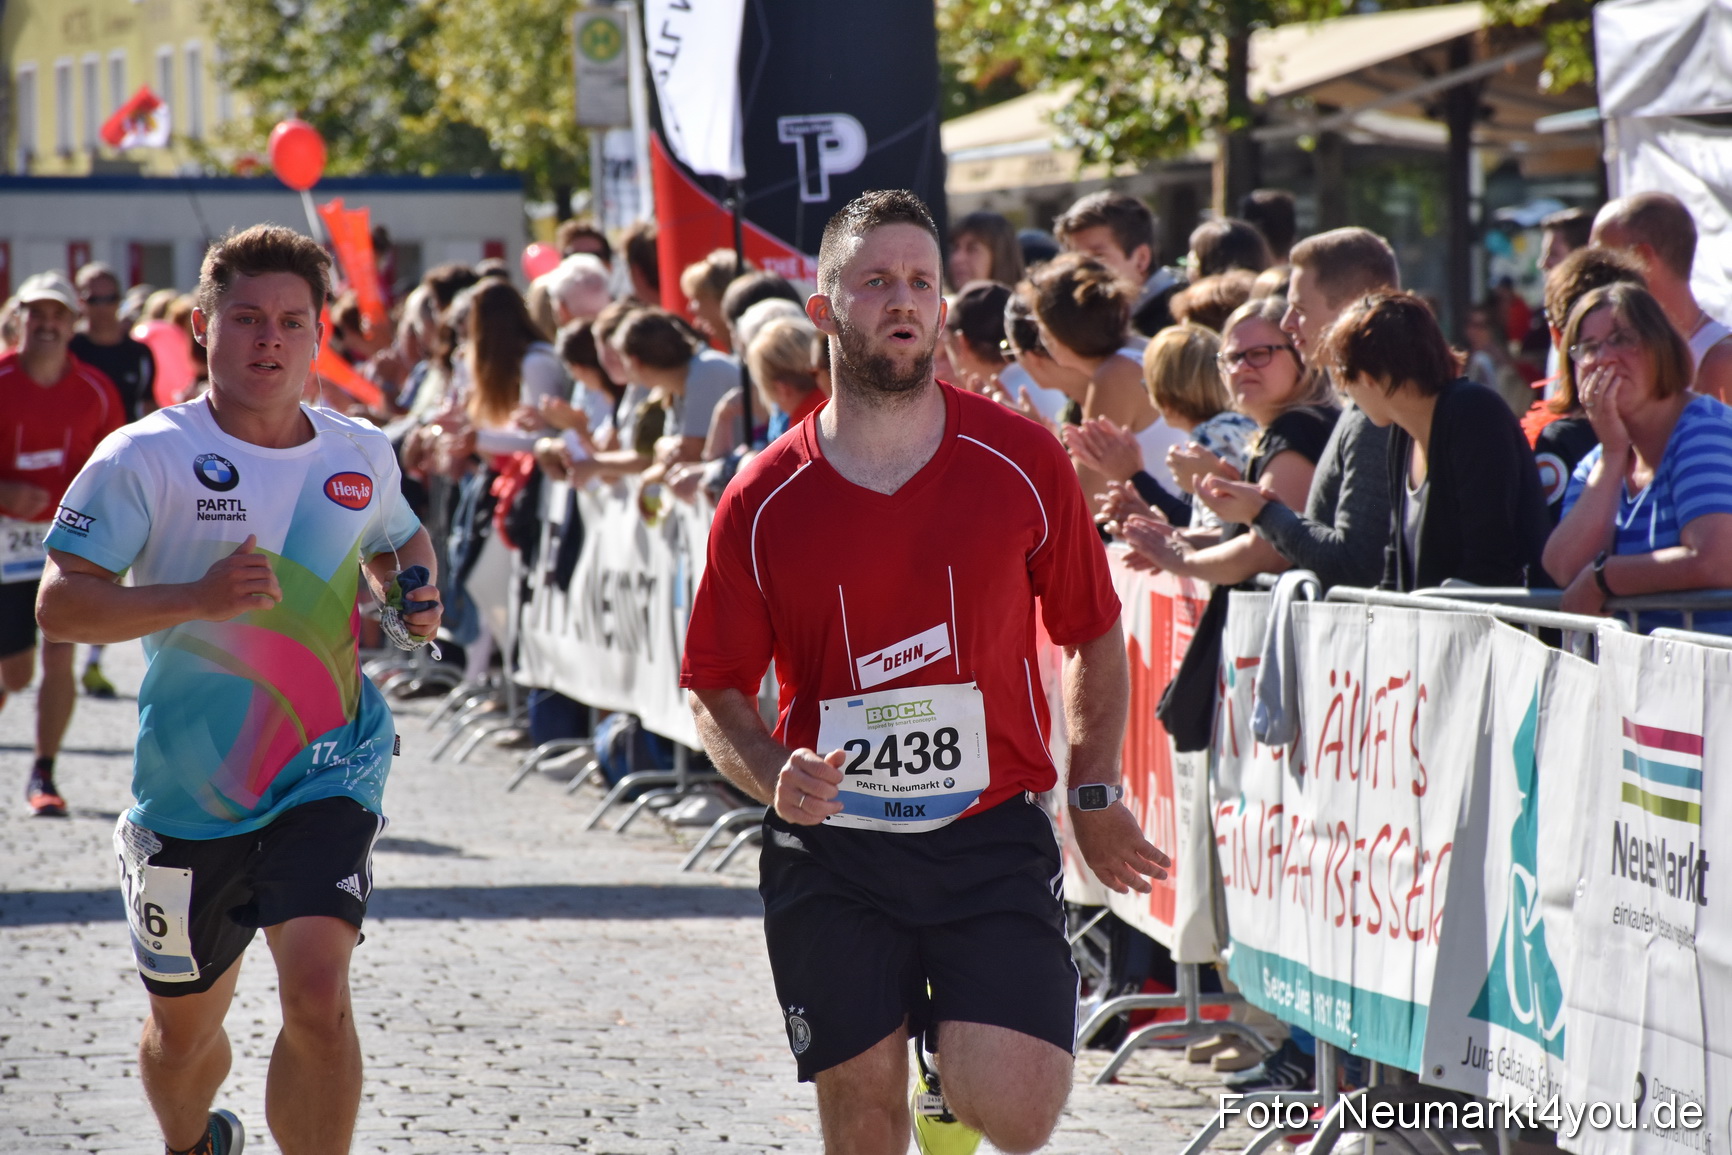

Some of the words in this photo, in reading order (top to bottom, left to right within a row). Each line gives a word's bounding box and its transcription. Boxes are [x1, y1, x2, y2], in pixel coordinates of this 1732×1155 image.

[196, 452, 233, 468] BMW
[332, 481, 370, 500] Hervis
[196, 499, 247, 513] PARTL
[196, 512, 247, 522] Neumarkt
[883, 642, 924, 673] DEHN
[866, 699, 936, 725] BOCK
[867, 722, 887, 731] inspired
[895, 719, 912, 727] smart
[912, 716, 937, 724] concepts
[311, 741, 340, 765] 17.
[843, 726, 963, 778] 2438
[856, 780, 890, 793] PARTL
[891, 780, 940, 793] Neumarkt
[884, 801, 926, 818] Max
[1460, 1036, 1493, 1072] Jura
